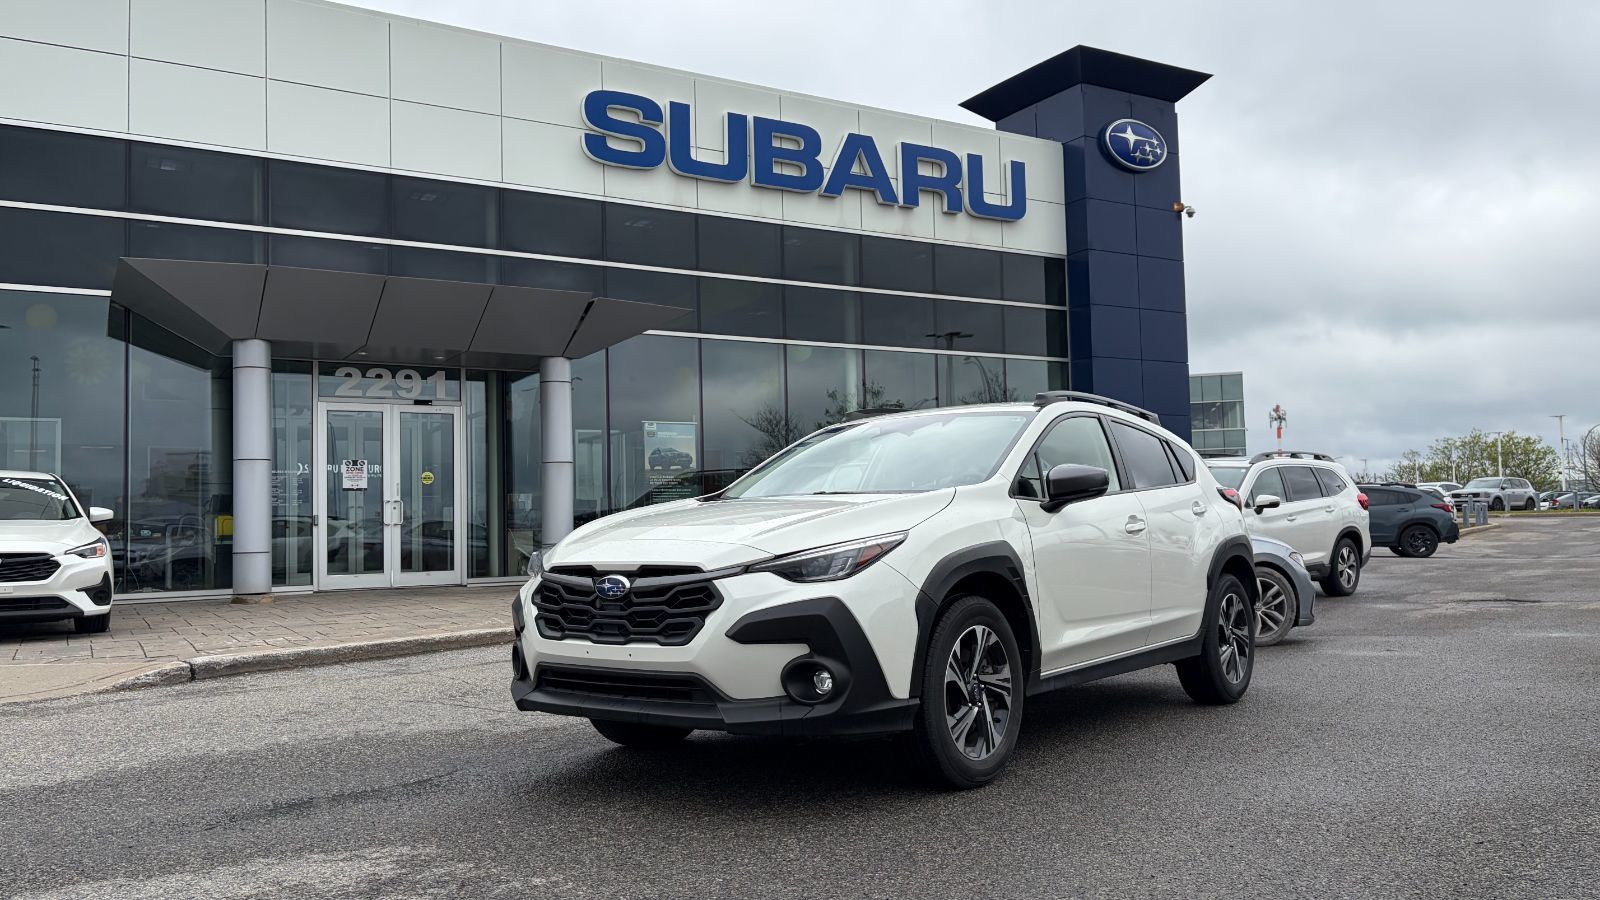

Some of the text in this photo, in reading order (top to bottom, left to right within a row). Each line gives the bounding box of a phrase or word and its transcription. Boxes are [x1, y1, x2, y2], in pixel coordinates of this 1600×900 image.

[580, 89, 1028, 222] SUBARU
[334, 366, 446, 400] 2291
[2, 478, 70, 501] LIQUIDATION
